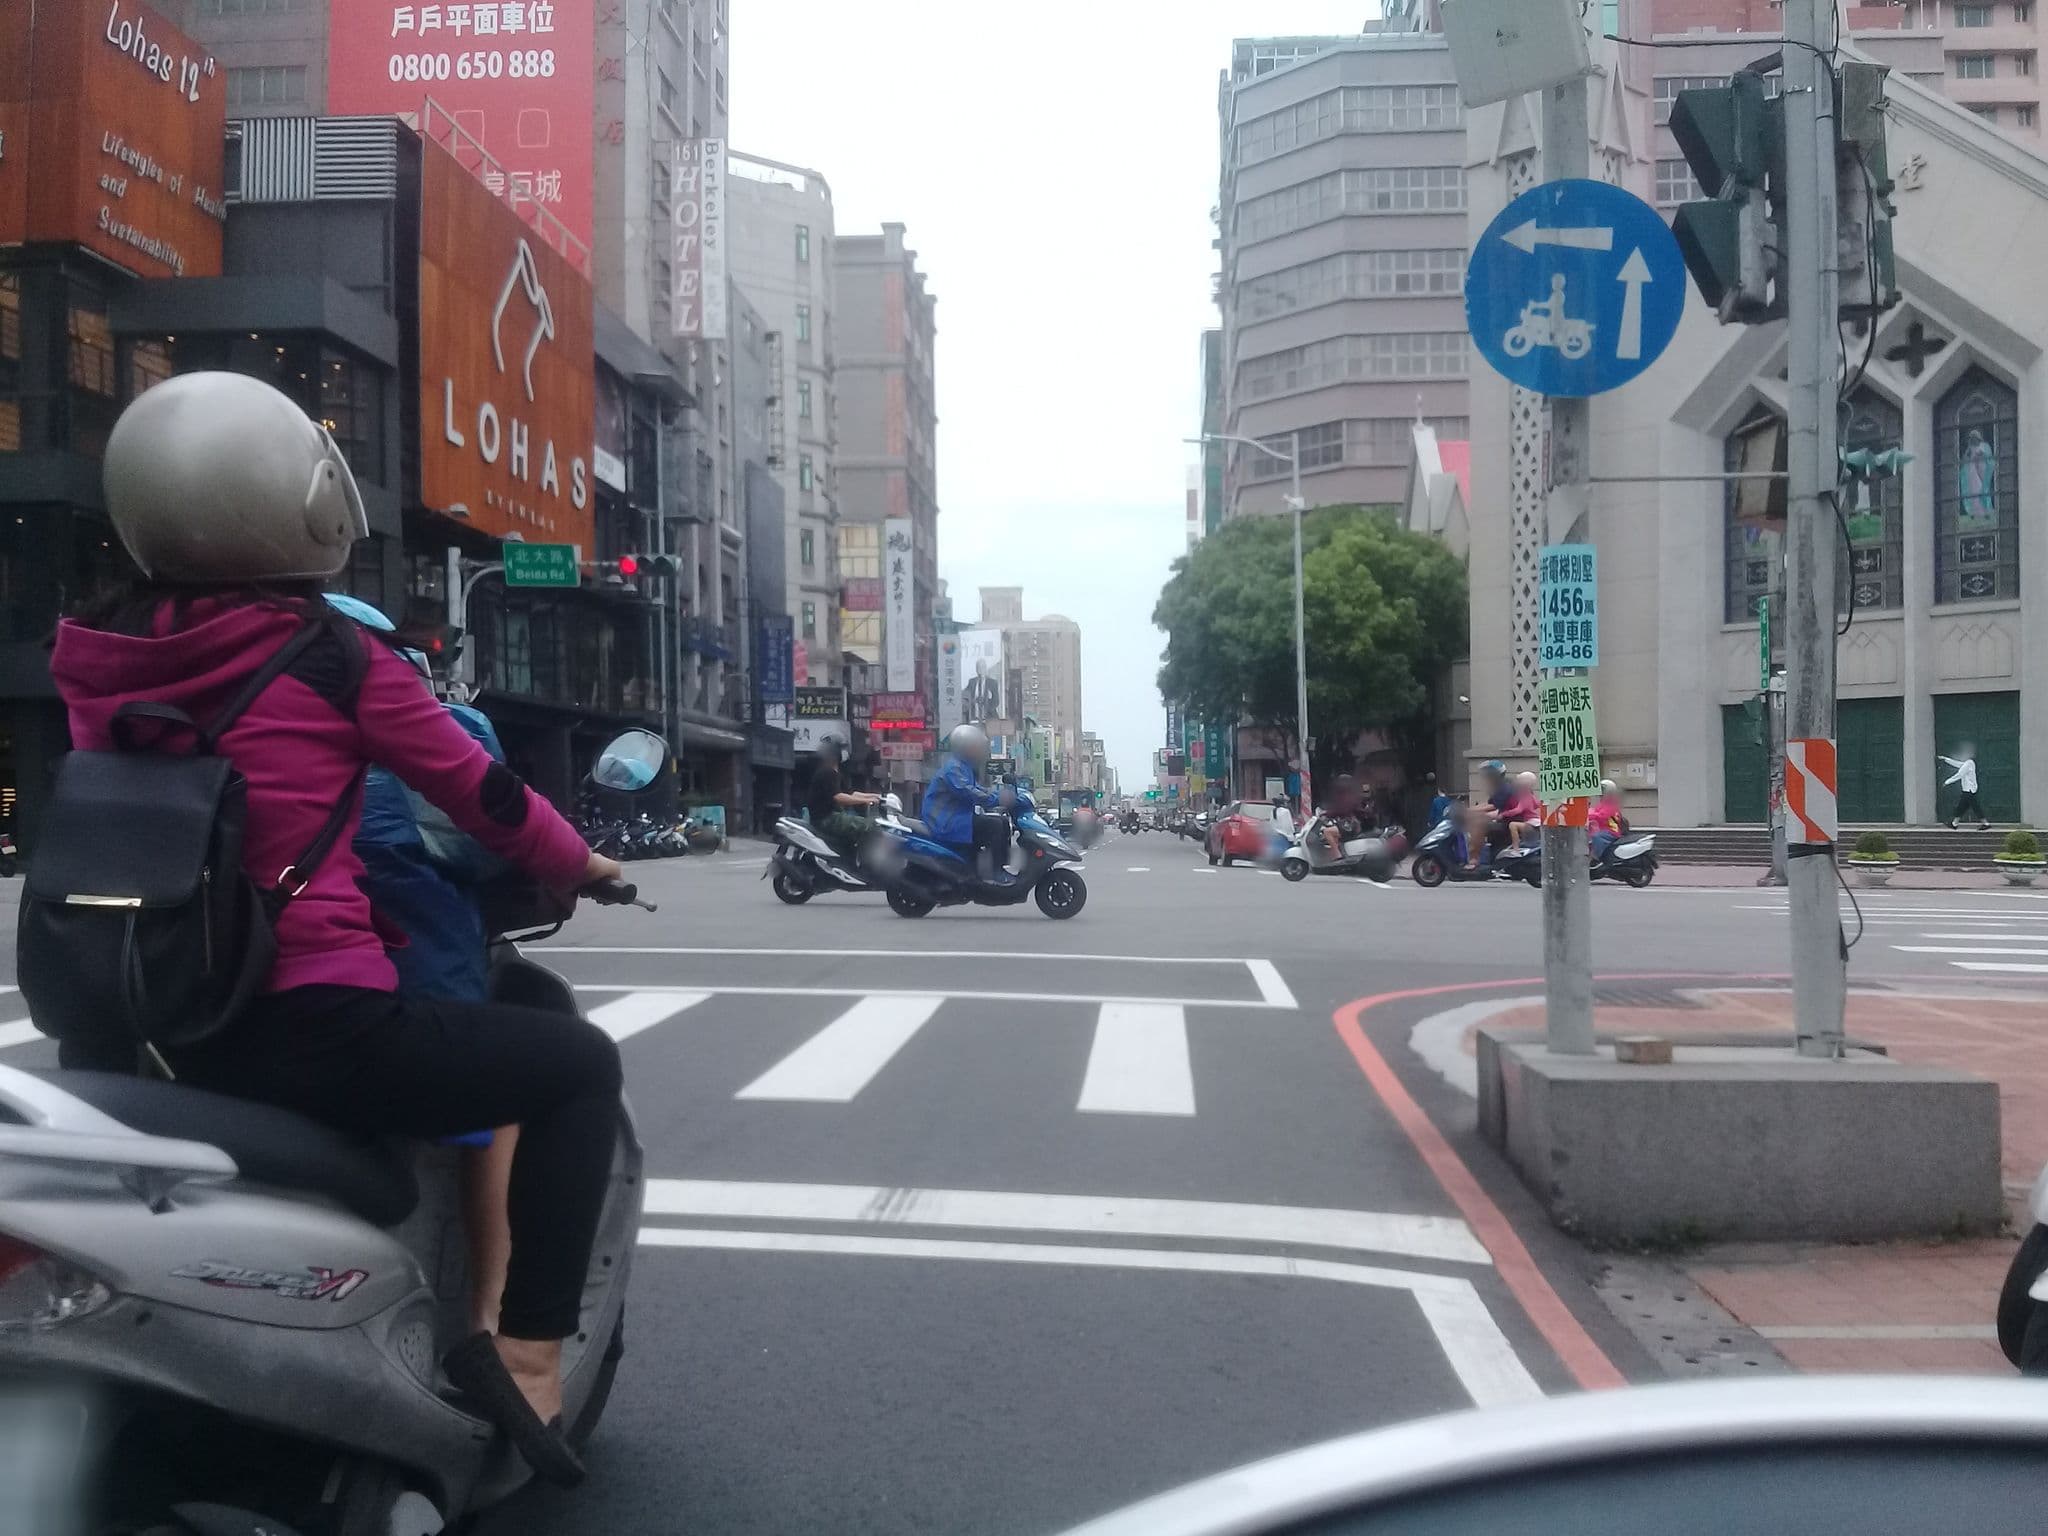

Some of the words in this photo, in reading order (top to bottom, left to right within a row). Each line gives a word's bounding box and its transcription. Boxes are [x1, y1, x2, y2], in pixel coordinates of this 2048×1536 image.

[106, 0, 173, 82] Lohas
[391, 1, 555, 38] 戶戶平面車位
[389, 53, 451, 82] 0800
[456, 51, 503, 79] 650
[508, 49, 555, 78] 888
[102, 130, 163, 183] Lifestyles
[170, 174, 184, 195] of
[676, 144, 699, 161] 161
[101, 174, 127, 198] and
[704, 141, 719, 249] Berkeley
[100, 205, 185, 276] Sustainability
[675, 166, 699, 332] HOTEL
[444, 377, 586, 510] LOHAS
[1540, 644, 1593, 660] -84-86
[1540, 686, 1592, 715] 光國中透天
